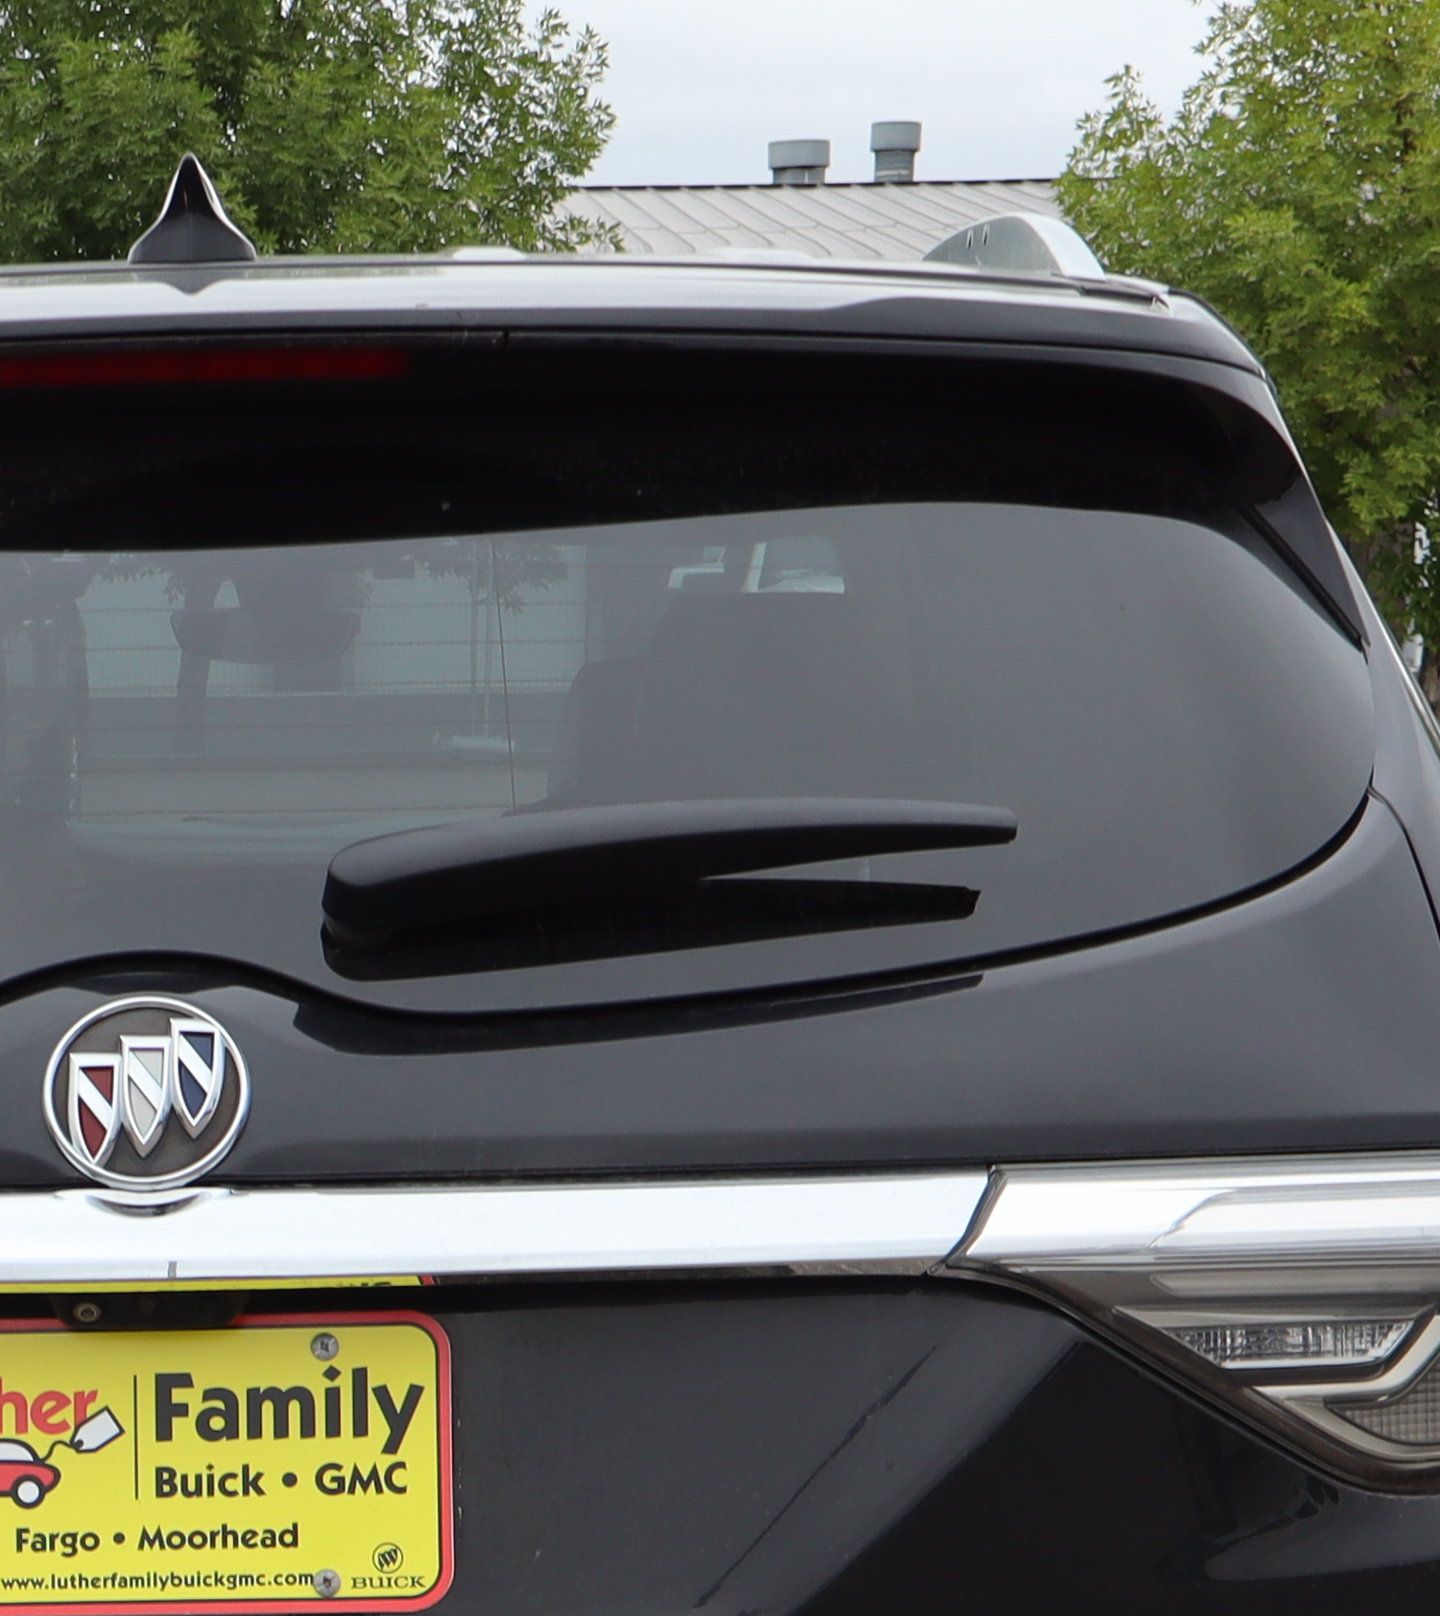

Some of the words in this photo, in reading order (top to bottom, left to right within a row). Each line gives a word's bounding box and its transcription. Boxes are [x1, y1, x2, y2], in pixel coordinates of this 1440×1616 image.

[154, 1364, 426, 1456] Family
[154, 1463, 266, 1499] Buick
[314, 1461, 409, 1496] GMC
[15, 1527, 100, 1558] Fargo
[137, 1521, 300, 1551] Moorhead
[0, 1570, 315, 1592] www.lutherfamilybuickgmc.com
[350, 1576, 427, 1590] BUICK
